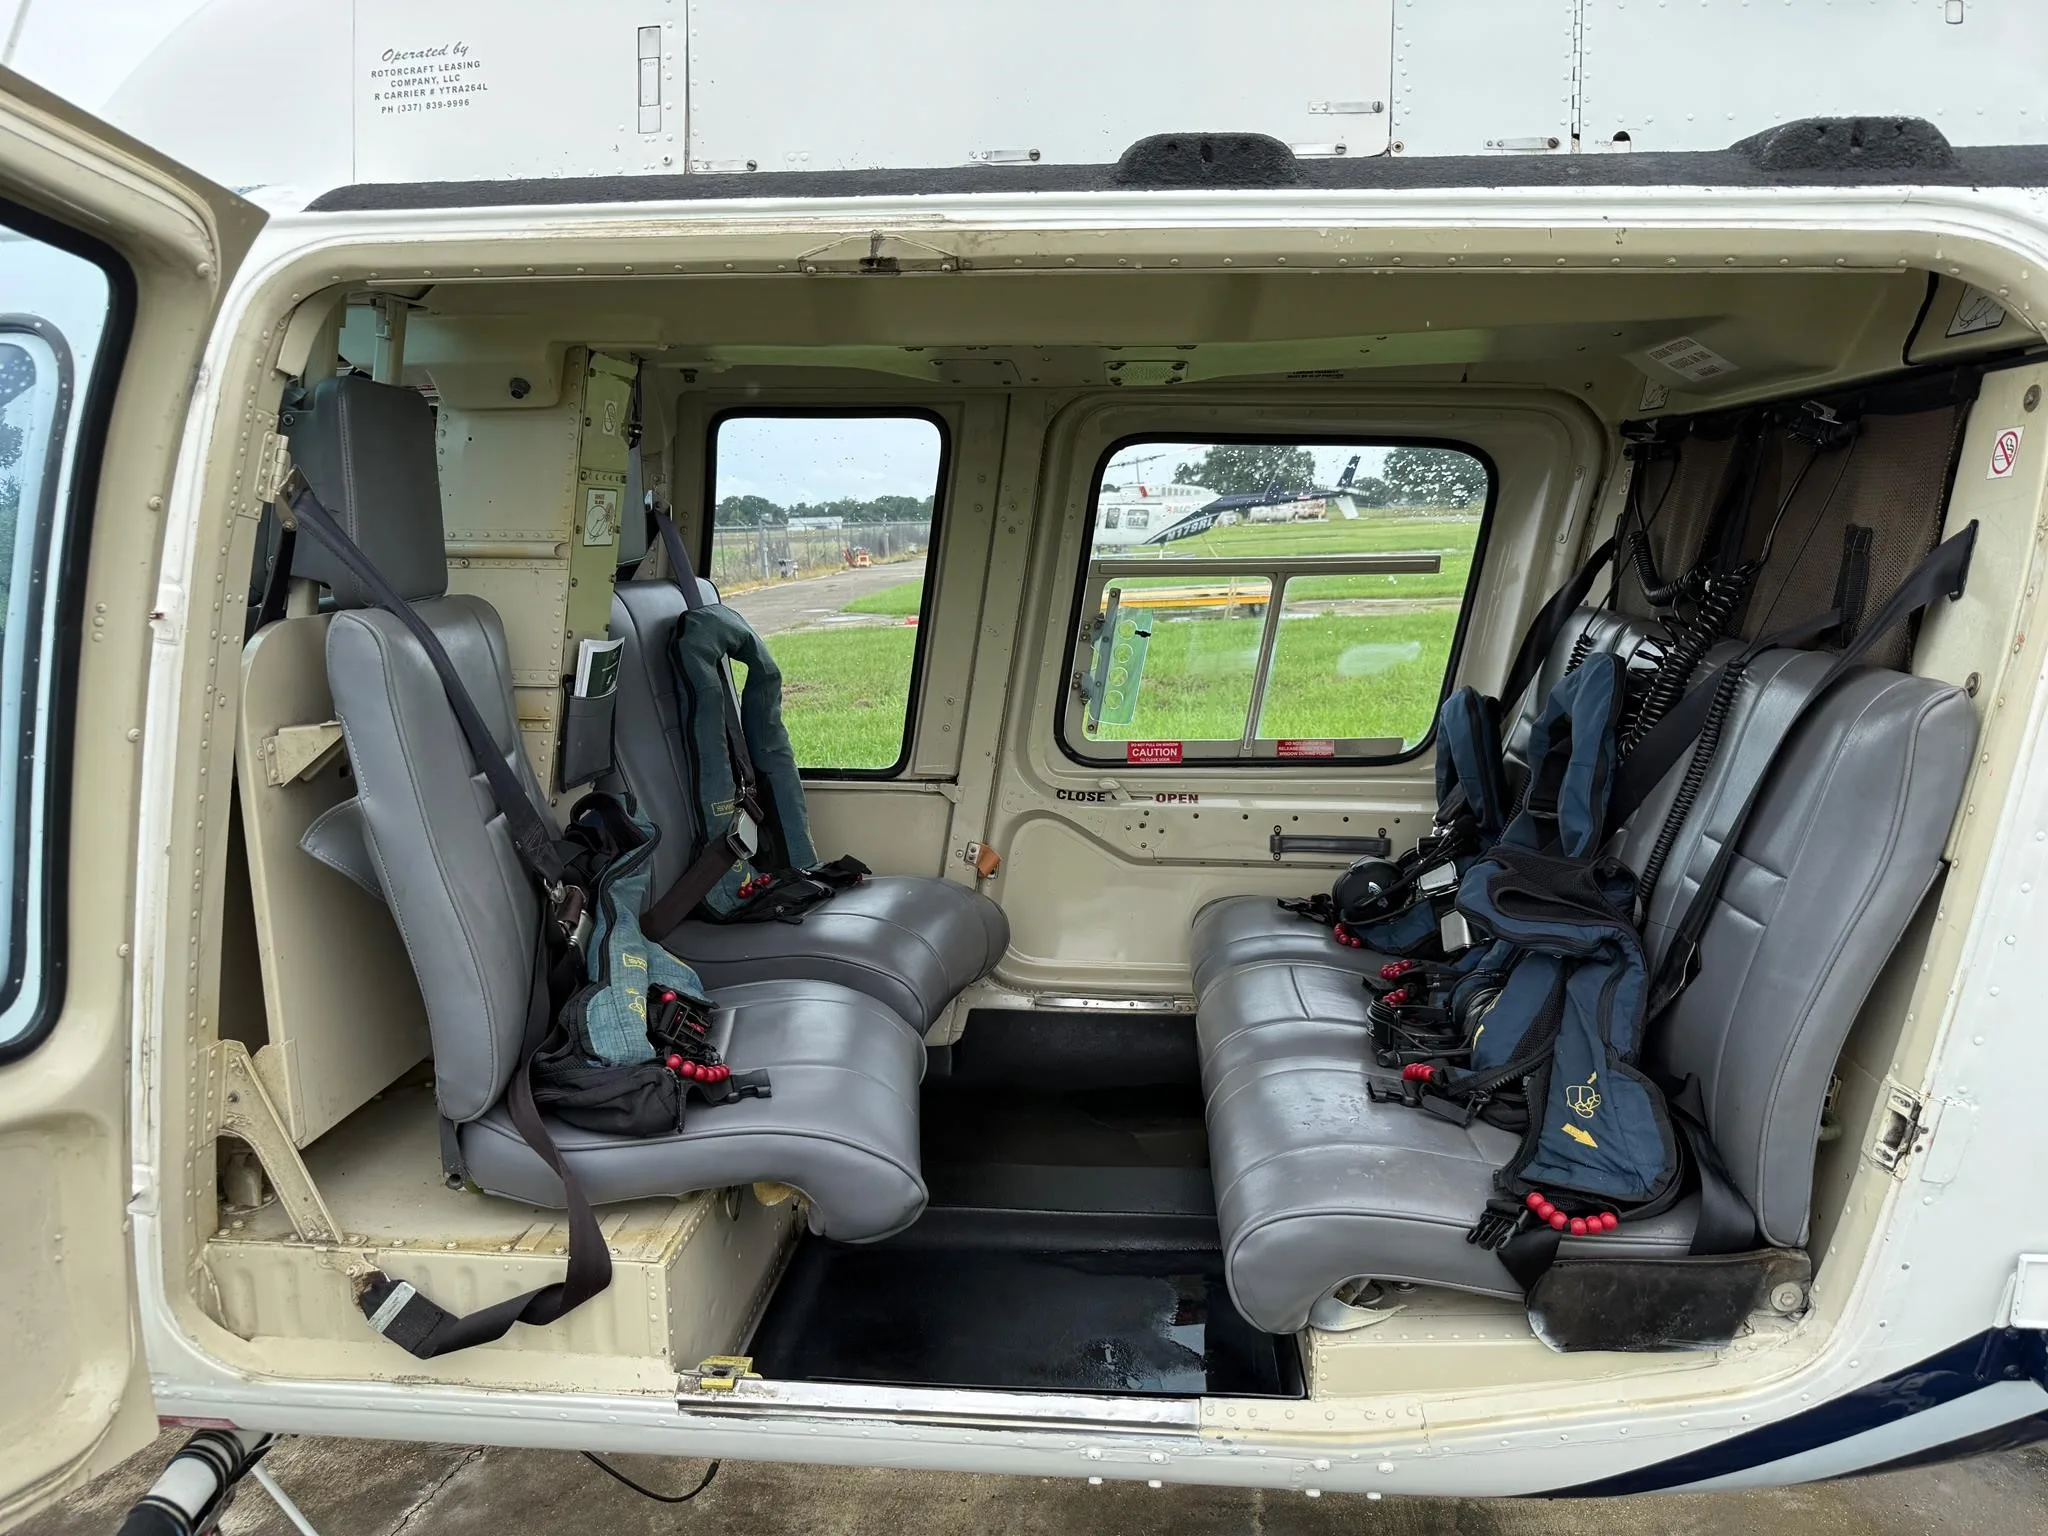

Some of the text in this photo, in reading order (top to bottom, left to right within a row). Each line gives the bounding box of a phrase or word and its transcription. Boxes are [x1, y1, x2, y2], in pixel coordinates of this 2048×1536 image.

[381, 41, 469, 64] Operated by
[371, 60, 481, 78] ROTORCRAFT LEASING
[391, 74, 461, 88] COMPANY, LLC
[384, 89, 426, 99] CARRIER
[381, 106, 394, 114] PH
[397, 103, 422, 114] (337)
[1132, 748, 1177, 757] CAUTION
[1056, 789, 1199, 804] CLOSE OPEN
